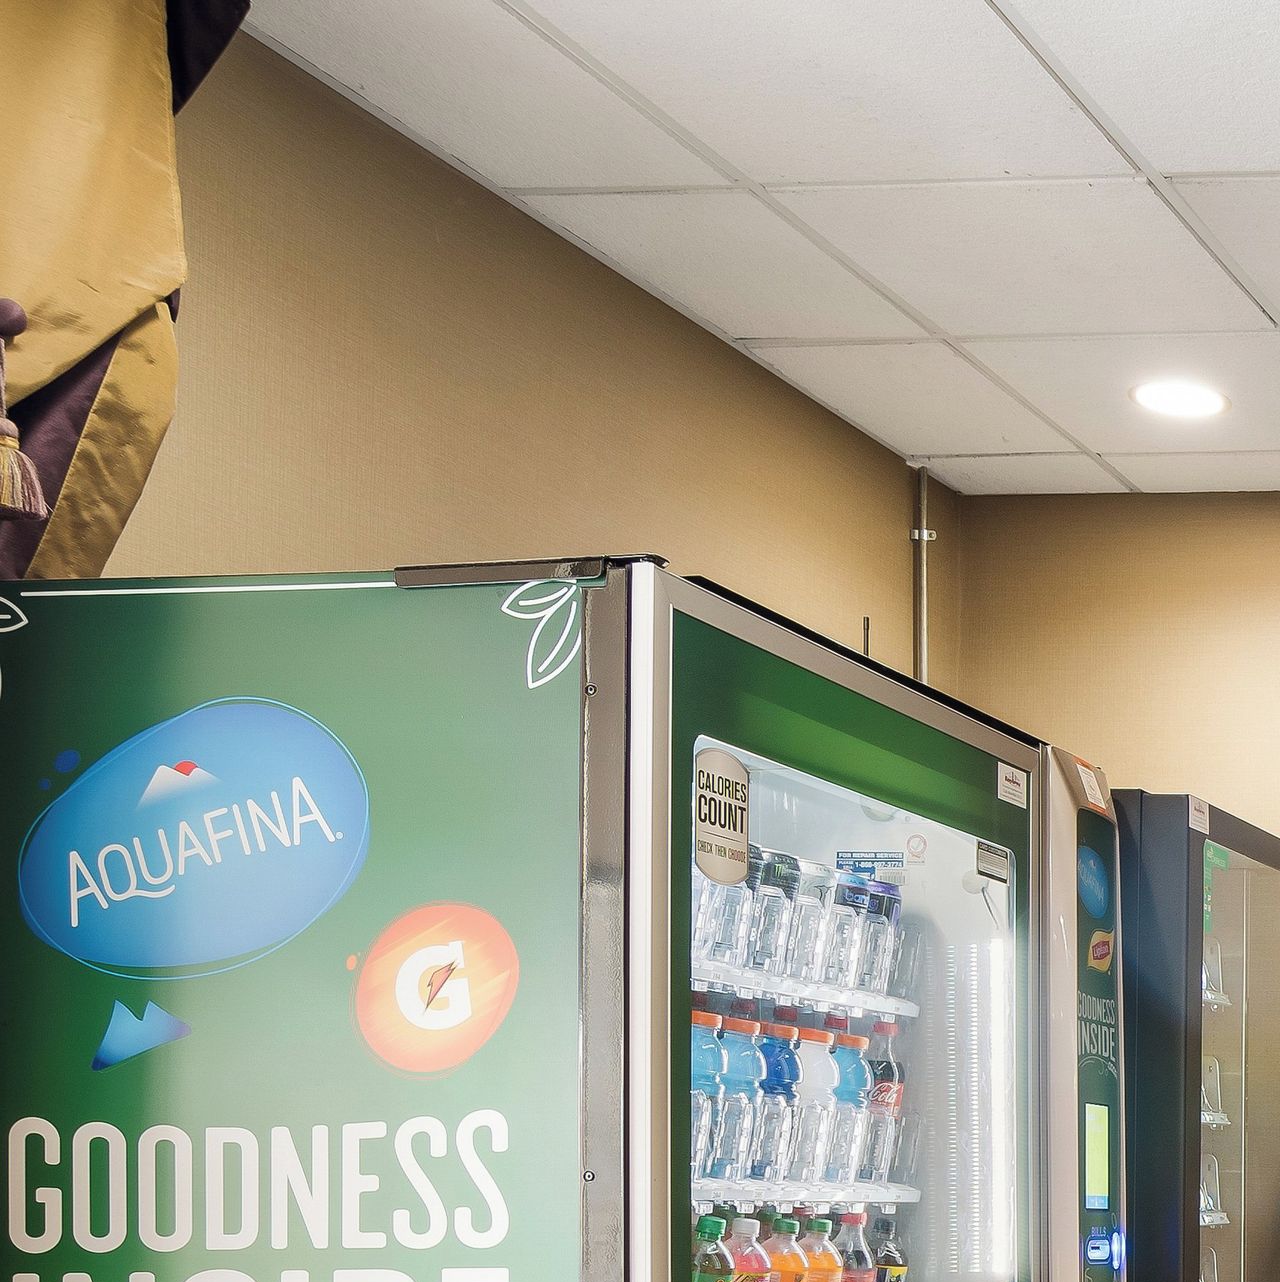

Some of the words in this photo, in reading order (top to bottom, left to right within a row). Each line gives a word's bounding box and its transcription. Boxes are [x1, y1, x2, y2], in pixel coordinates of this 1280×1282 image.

[698, 769, 747, 803] CALORIES
[698, 793, 747, 834] COUNT
[68, 776, 336, 928] AQUAFINA
[697, 839, 713, 855] CHECK
[714, 844, 727, 859] THEN
[394, 939, 472, 1031] G
[1078, 1020, 1116, 1062] INSIDE
[8, 1108, 512, 1254] GOODNESS
